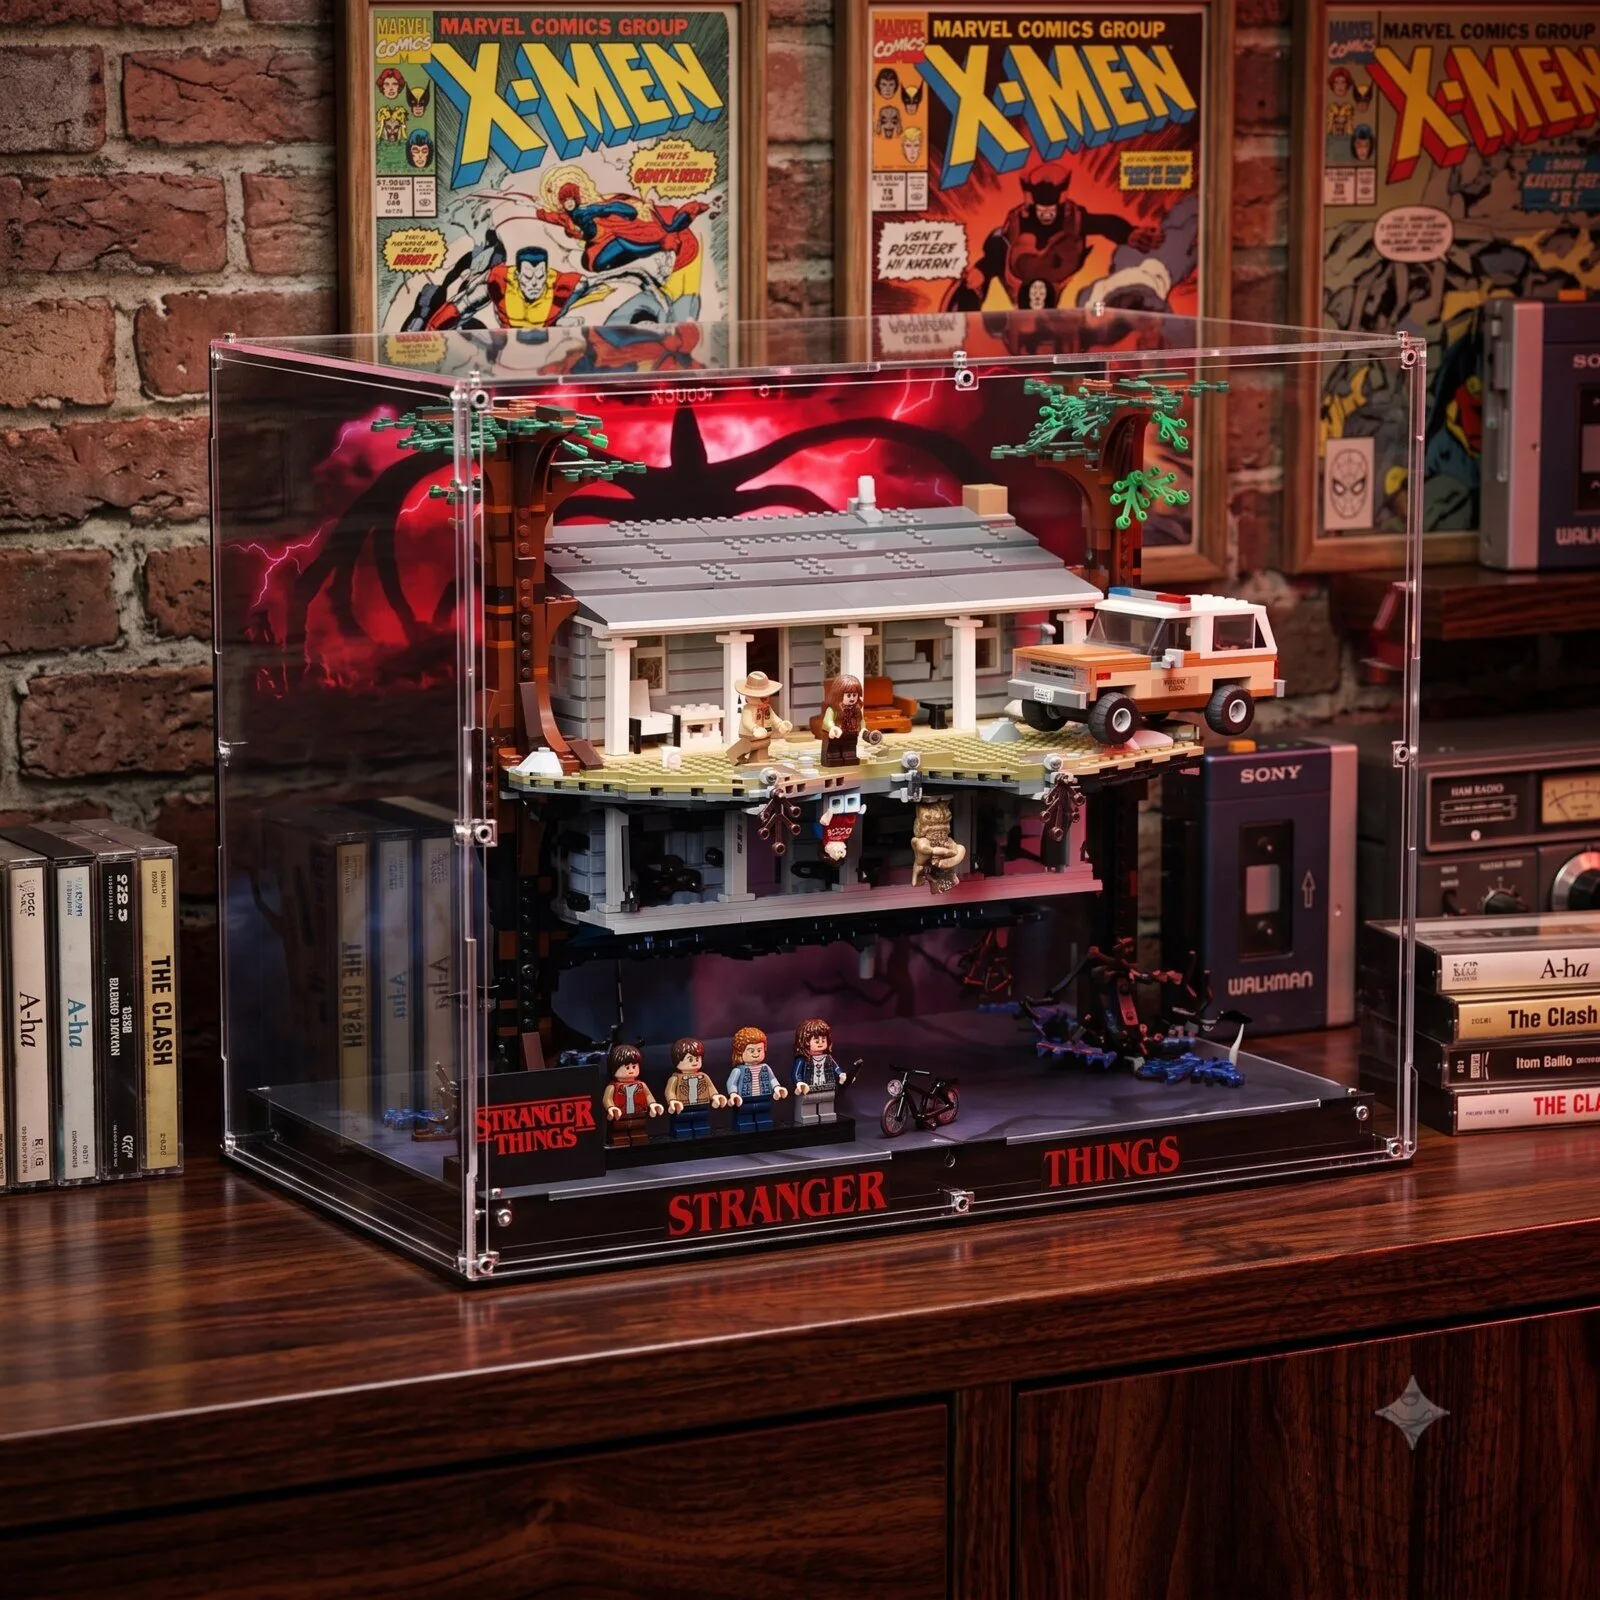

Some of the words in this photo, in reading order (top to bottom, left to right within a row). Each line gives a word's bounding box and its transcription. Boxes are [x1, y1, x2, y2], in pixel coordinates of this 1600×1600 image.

[376, 17, 430, 35] MARVEL
[440, 18, 525, 36] MARVEL
[530, 18, 612, 36] COMICS
[618, 18, 689, 36] GROUP
[933, 20, 1013, 38] MARVEL
[1018, 20, 1094, 38] COMICS
[1099, 20, 1167, 39] GROUP
[1383, 23, 1455, 39] MARVEL
[1460, 23, 1529, 40] COMICS
[1535, 23, 1596, 40] GROUP
[421, 42, 725, 190] X-MEN
[914, 45, 1198, 190] X-MEN
[1240, 765, 1302, 784] SONY
[1474, 783, 1505, 796] RADIO
[151, 955, 172, 994] THE
[1540, 957, 1590, 979] A-ha
[1228, 970, 1313, 996] WALKMAN
[19, 991, 44, 1048] A-ha
[67, 998, 89, 1048] A-ha
[1508, 1009, 1541, 1029] The
[1547, 1005, 1598, 1027] Clash
[152, 1001, 173, 1066] CLASH
[475, 1100, 596, 1137] STRANGER
[1533, 1095, 1567, 1116] THE
[494, 1126, 577, 1155] THINGS
[668, 1171, 887, 1237] STRANGER
[1043, 1135, 1180, 1188] THINGS
